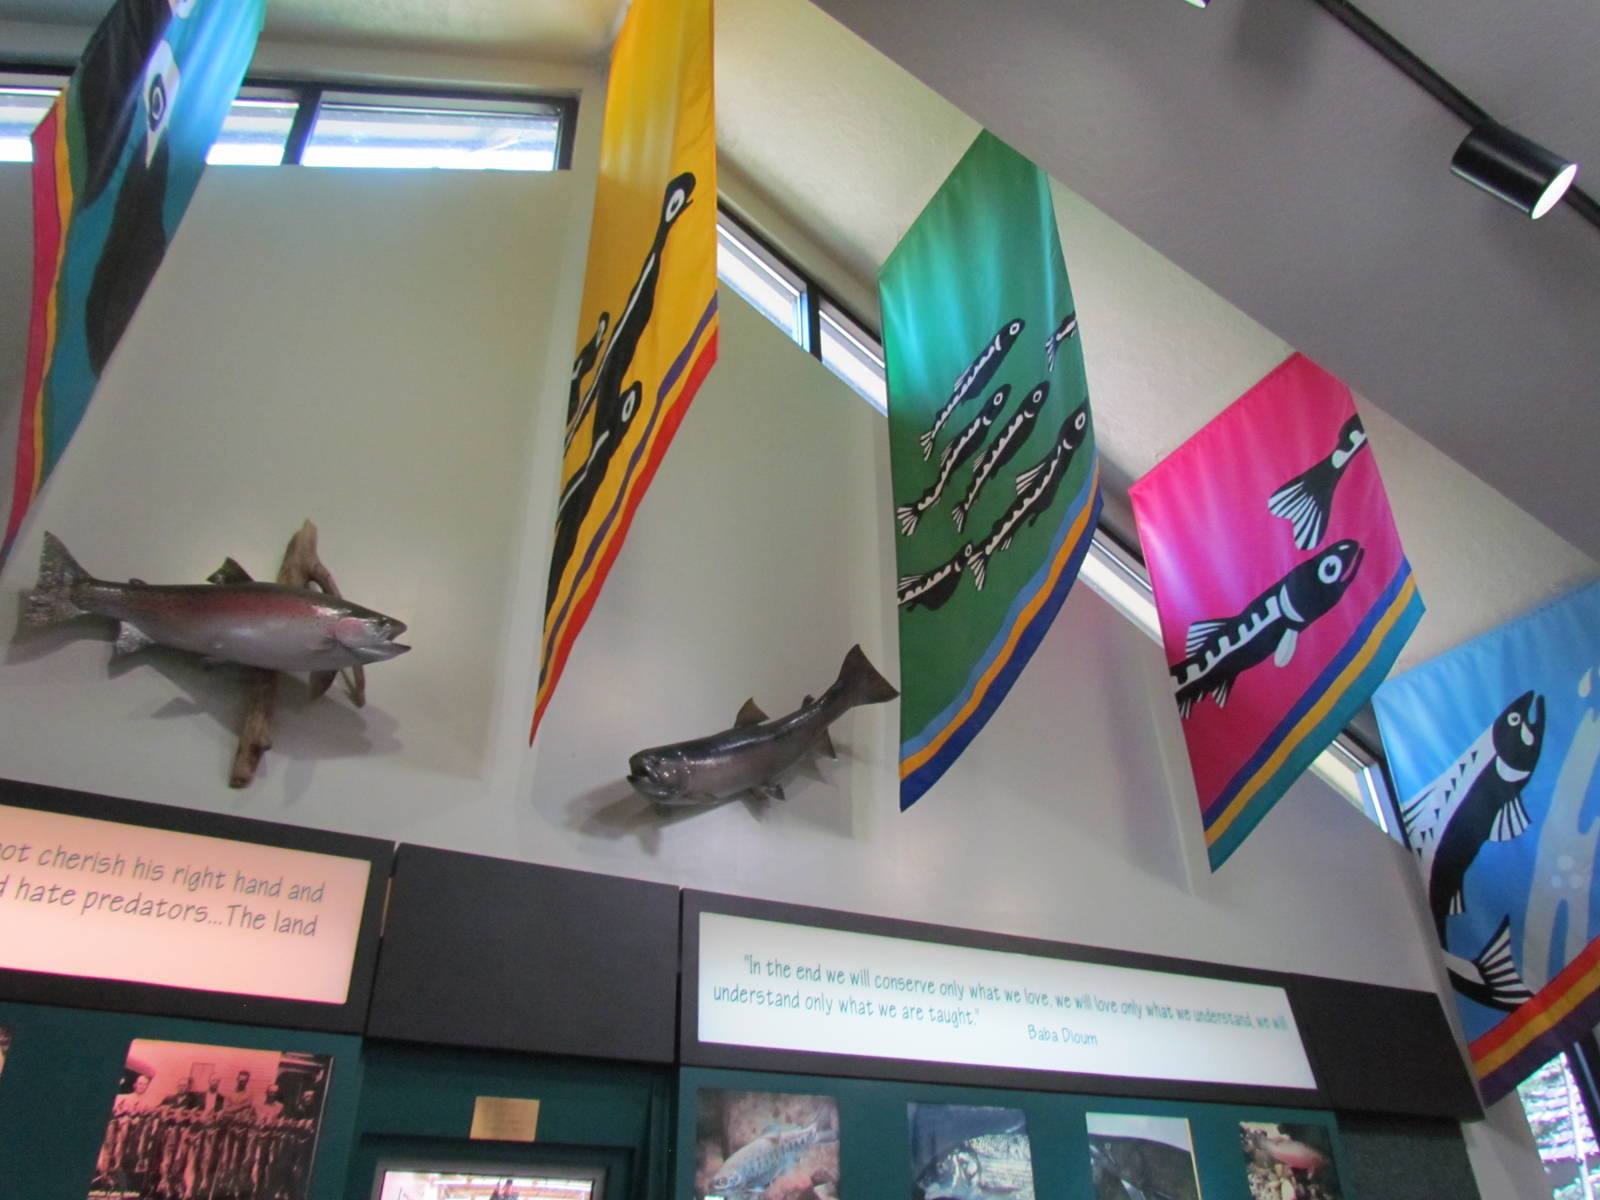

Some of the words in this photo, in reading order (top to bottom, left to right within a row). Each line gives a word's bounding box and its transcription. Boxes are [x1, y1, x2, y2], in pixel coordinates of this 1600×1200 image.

[0, 843, 32, 862] ot
[38, 844, 126, 877] cherish
[132, 858, 164, 881] his
[172, 864, 227, 891] right
[233, 873, 285, 898] hand
[288, 882, 325, 903] and
[15, 876, 76, 905] hate
[273, 910, 318, 937] land
[713, 983, 800, 1008] understand
[805, 992, 833, 1015] only
[838, 996, 873, 1016] what
[879, 1002, 897, 1018] we
[901, 1005, 924, 1021] are
[766, 960, 791, 978] the
[796, 964, 821, 982] end
[826, 969, 846, 984] we
[849, 968, 870, 988] will
[875, 973, 935, 994] conserve
[939, 979, 965, 998] only
[969, 981, 1000, 1001] what
[1004, 989, 1021, 1003] we
[1055, 994, 1071, 1009] we
[1074, 994, 1092, 1011] will
[1094, 995, 1118, 1013] love
[1120, 1000, 1143, 1020] only
[1146, 1001, 1173, 1019] what
[1176, 1007, 1191, 1021] we
[1256, 1016, 1270, 1028] we
[1027, 1024, 1058, 1042] Baba
[1061, 1027, 1098, 1046] Dioum
